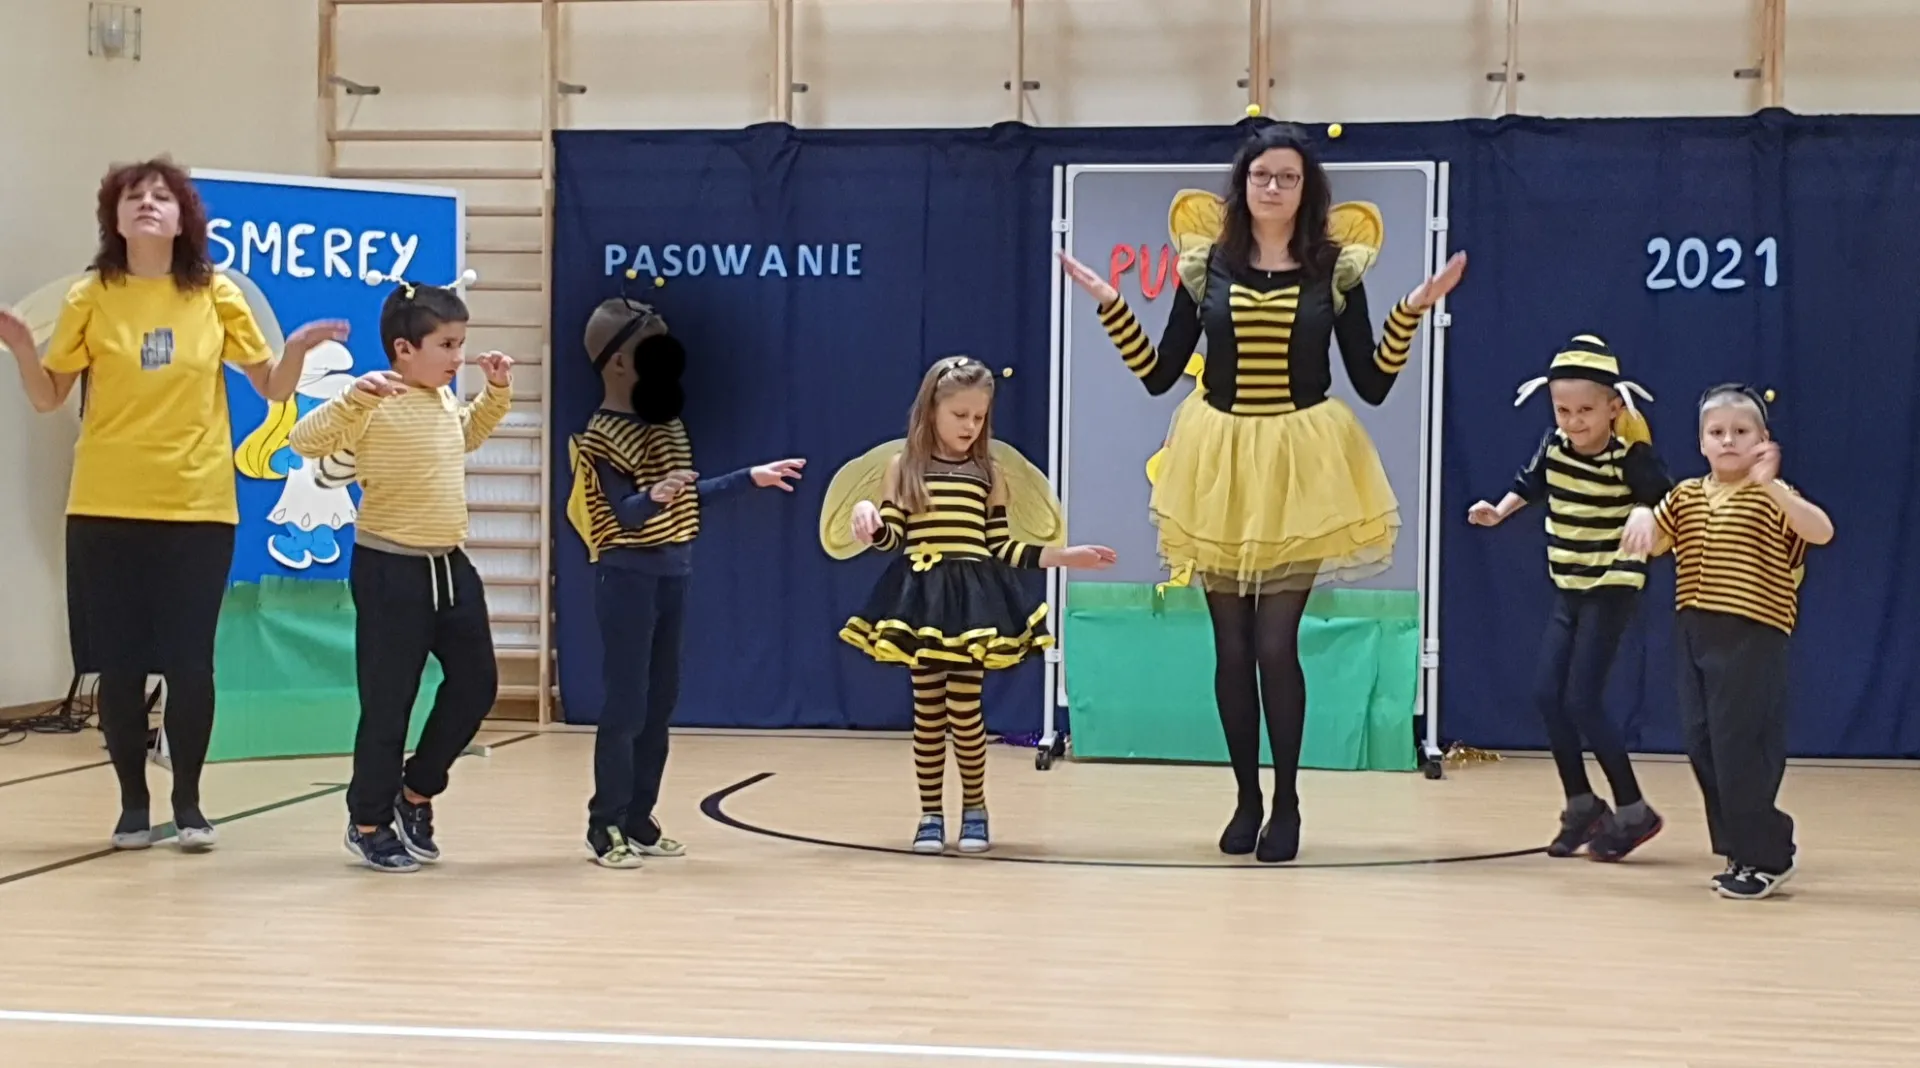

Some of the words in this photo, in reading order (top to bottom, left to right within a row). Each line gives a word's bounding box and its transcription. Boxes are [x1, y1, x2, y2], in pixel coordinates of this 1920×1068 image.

[206, 218, 418, 280] SMERFY
[604, 243, 862, 277] PASOWANIE
[1646, 236, 1778, 290] 2021
